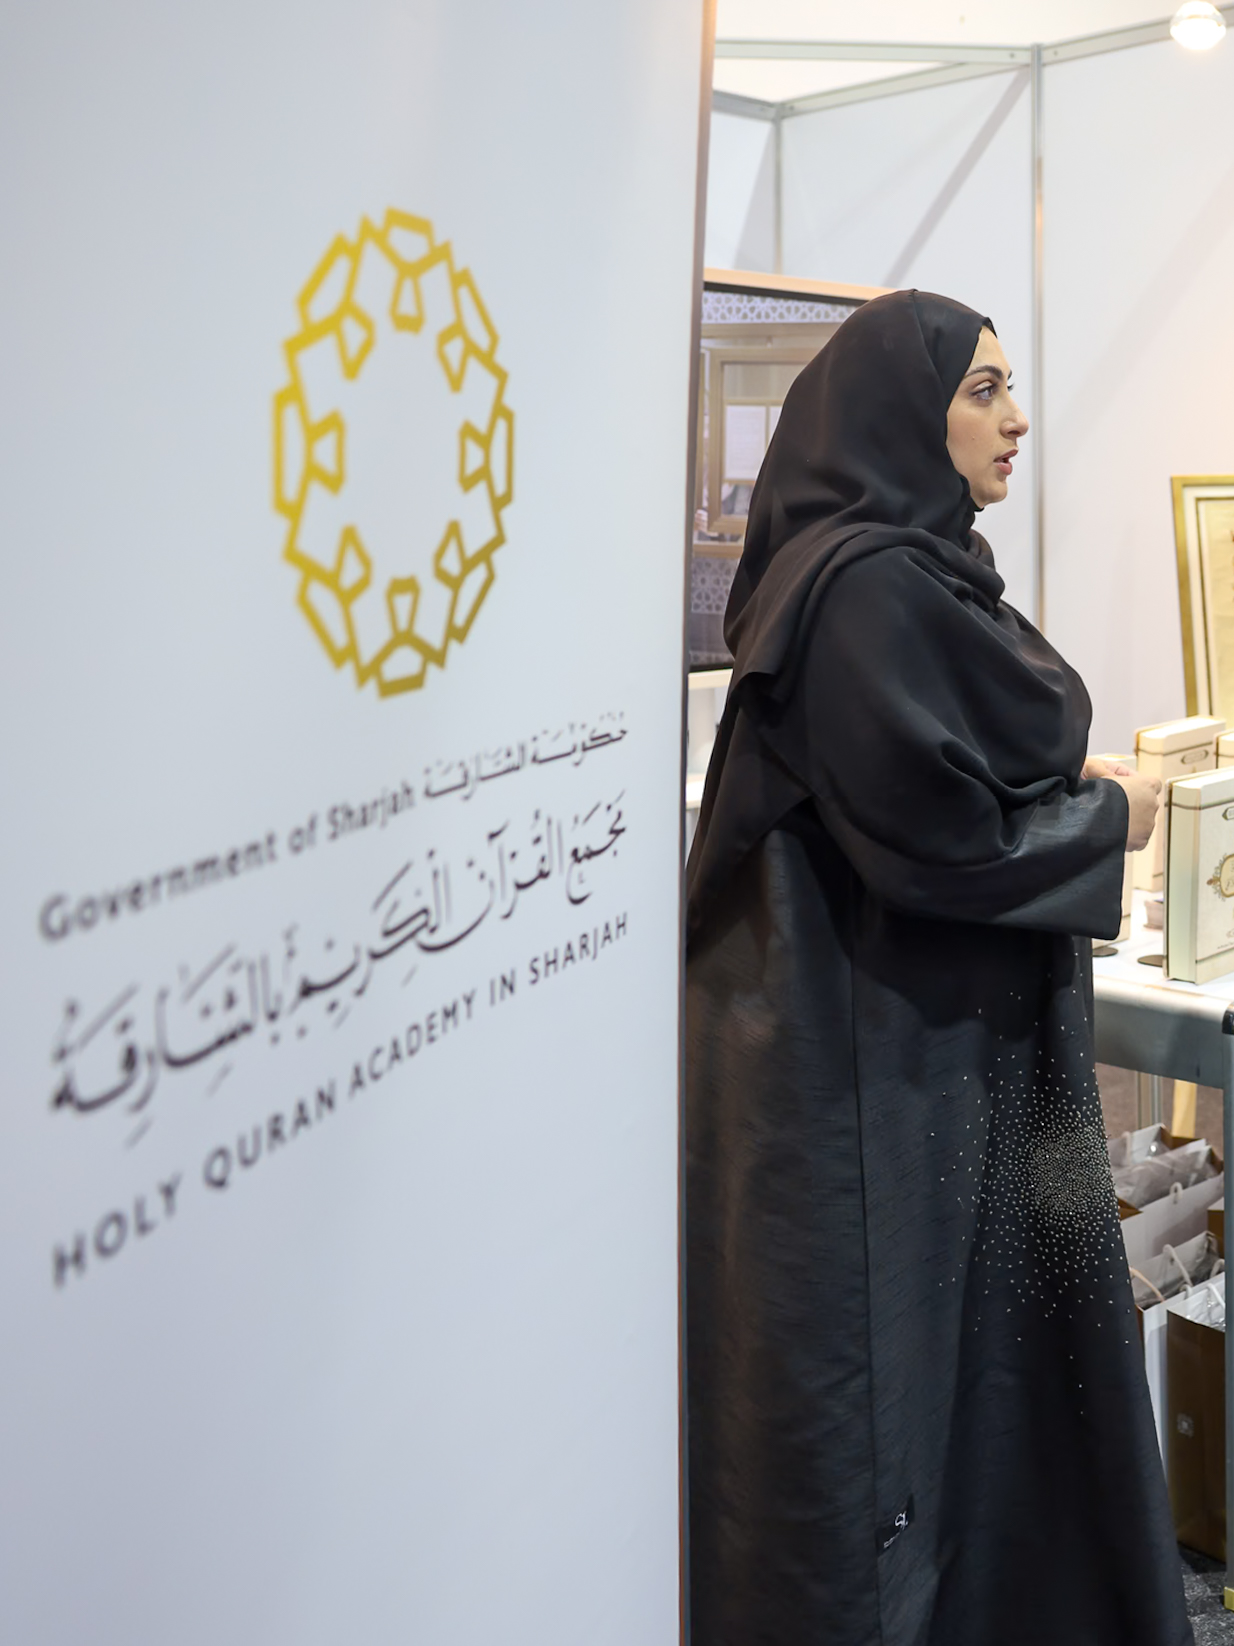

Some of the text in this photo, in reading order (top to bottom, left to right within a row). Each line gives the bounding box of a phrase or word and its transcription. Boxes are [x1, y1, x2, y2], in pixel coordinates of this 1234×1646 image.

[424, 712, 627, 801] حكومة الشارقة
[38, 781, 415, 943] Government of Sharjah
[566, 789, 627, 905] مجمع
[289, 848, 452, 1038] الكريم
[52, 911, 629, 1289] HOLY QURAN ACADEMY IN SHARJAH
